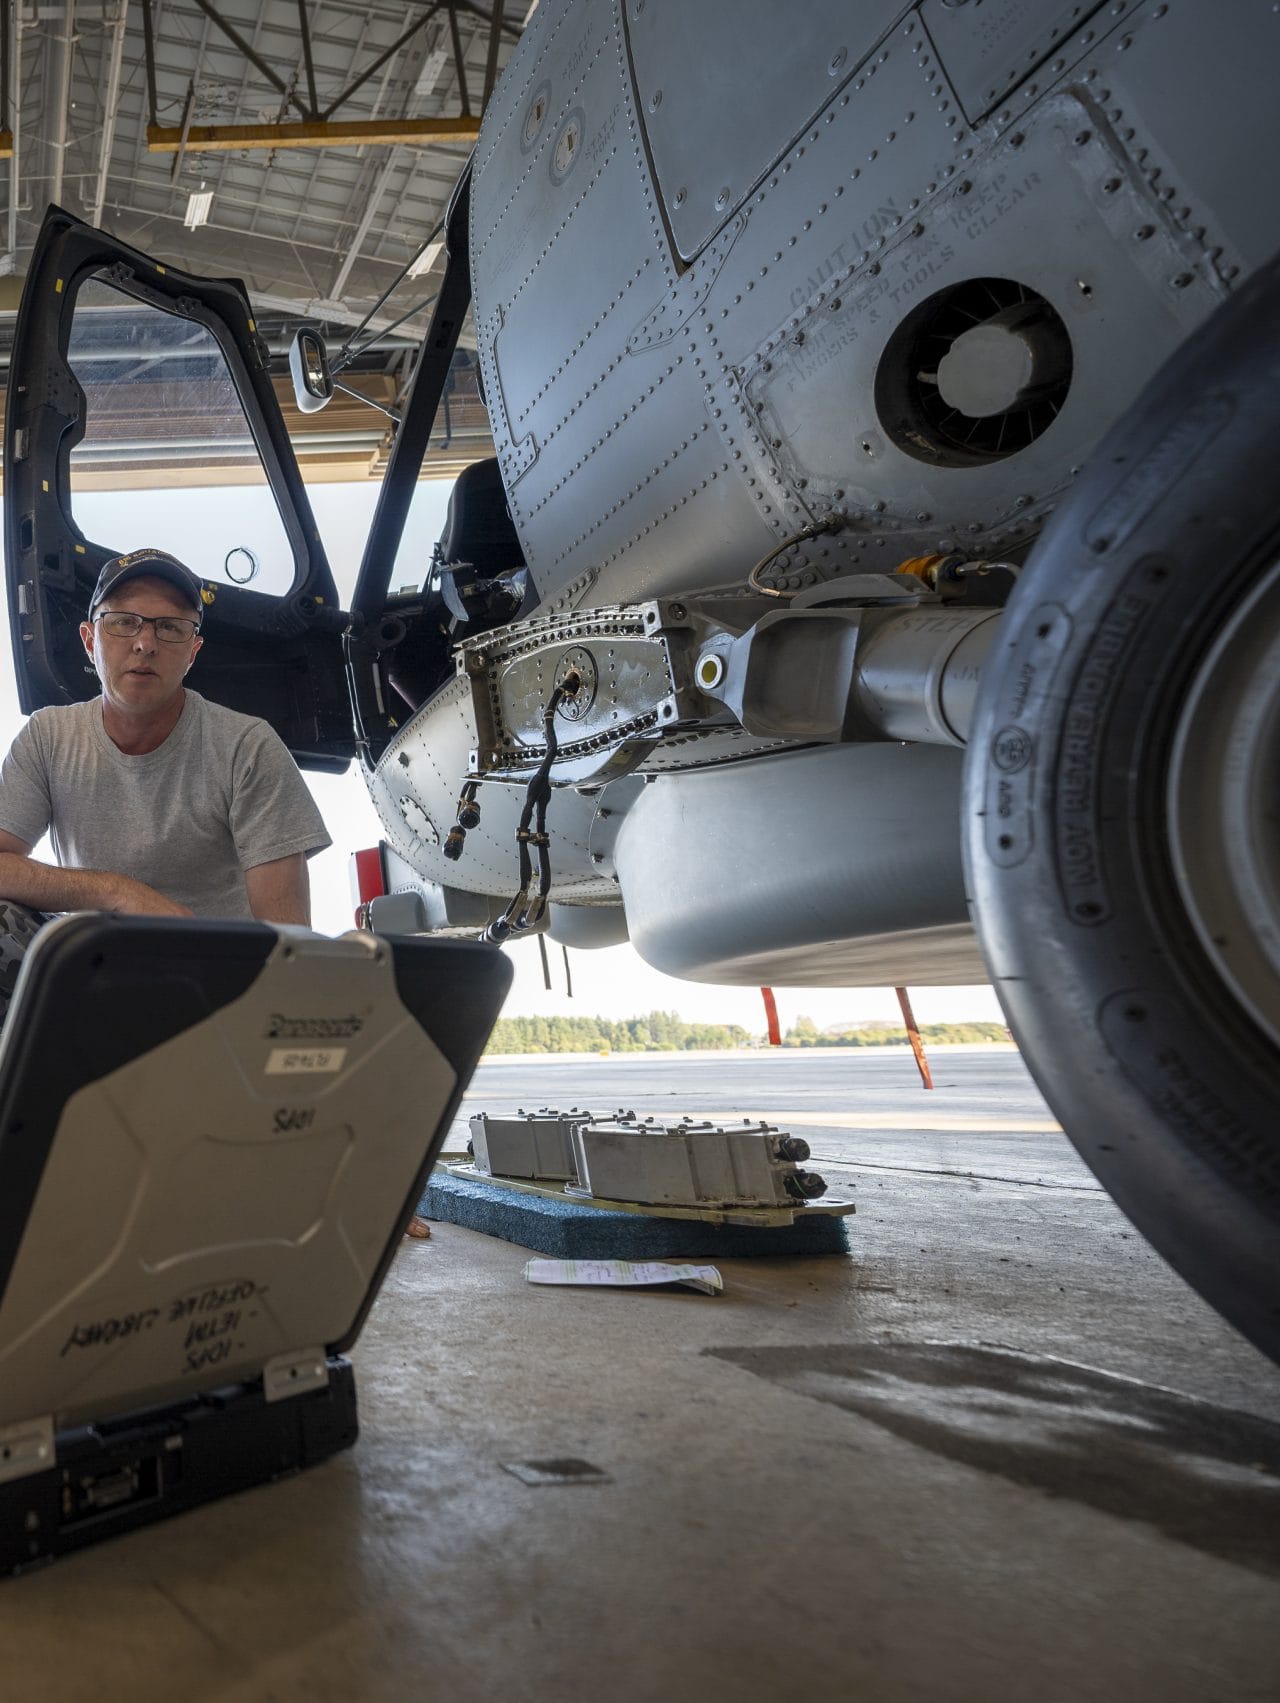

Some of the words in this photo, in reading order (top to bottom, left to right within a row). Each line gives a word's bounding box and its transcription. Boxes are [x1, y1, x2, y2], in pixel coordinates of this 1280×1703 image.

[789, 196, 900, 309] CAUTION
[834, 277, 890, 332] SPEED
[950, 173, 1007, 229] KEEP
[890, 244, 955, 304] TOOLS
[966, 171, 1042, 240] CLEAR
[1063, 593, 1146, 813] RETREADABLE
[1065, 826, 1098, 886] NOT
